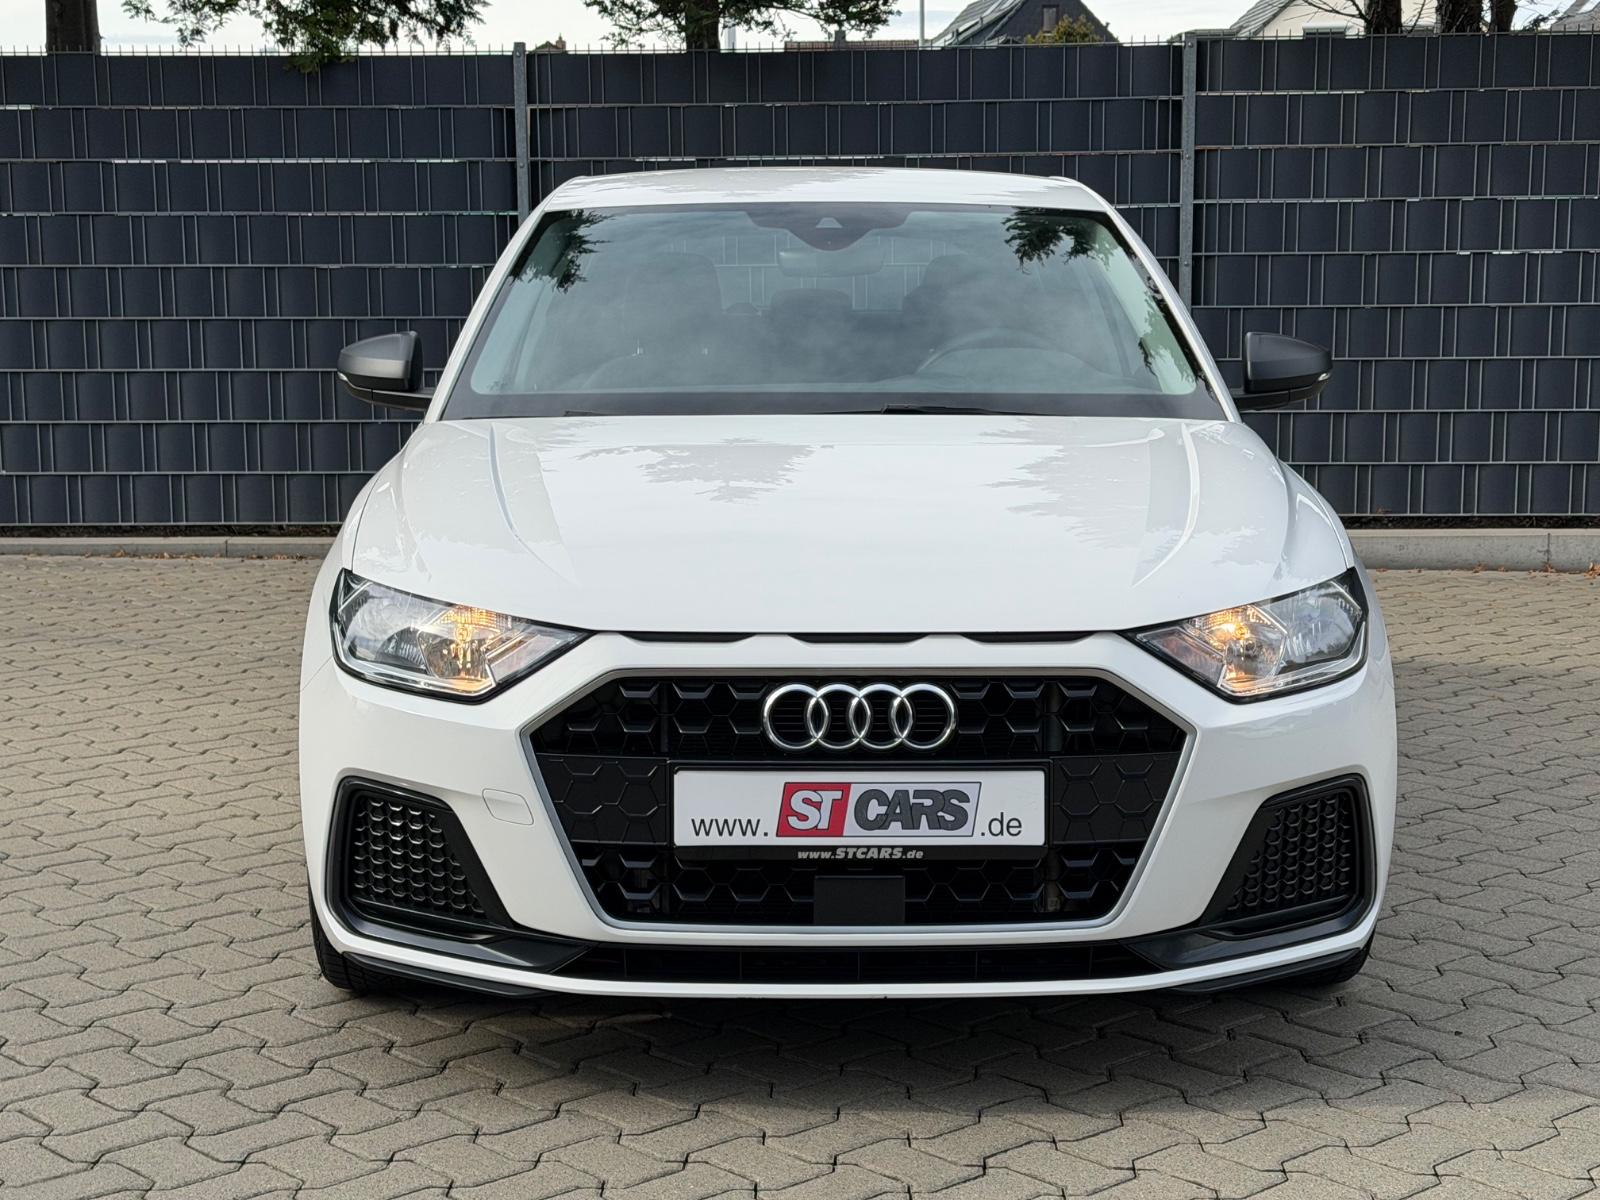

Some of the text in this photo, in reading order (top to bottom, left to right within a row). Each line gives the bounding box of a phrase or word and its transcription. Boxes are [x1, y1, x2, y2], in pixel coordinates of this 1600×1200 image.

[691, 818, 768, 837] www.
[854, 789, 971, 831] CARS
[797, 847, 924, 860] www.STCARS.de
